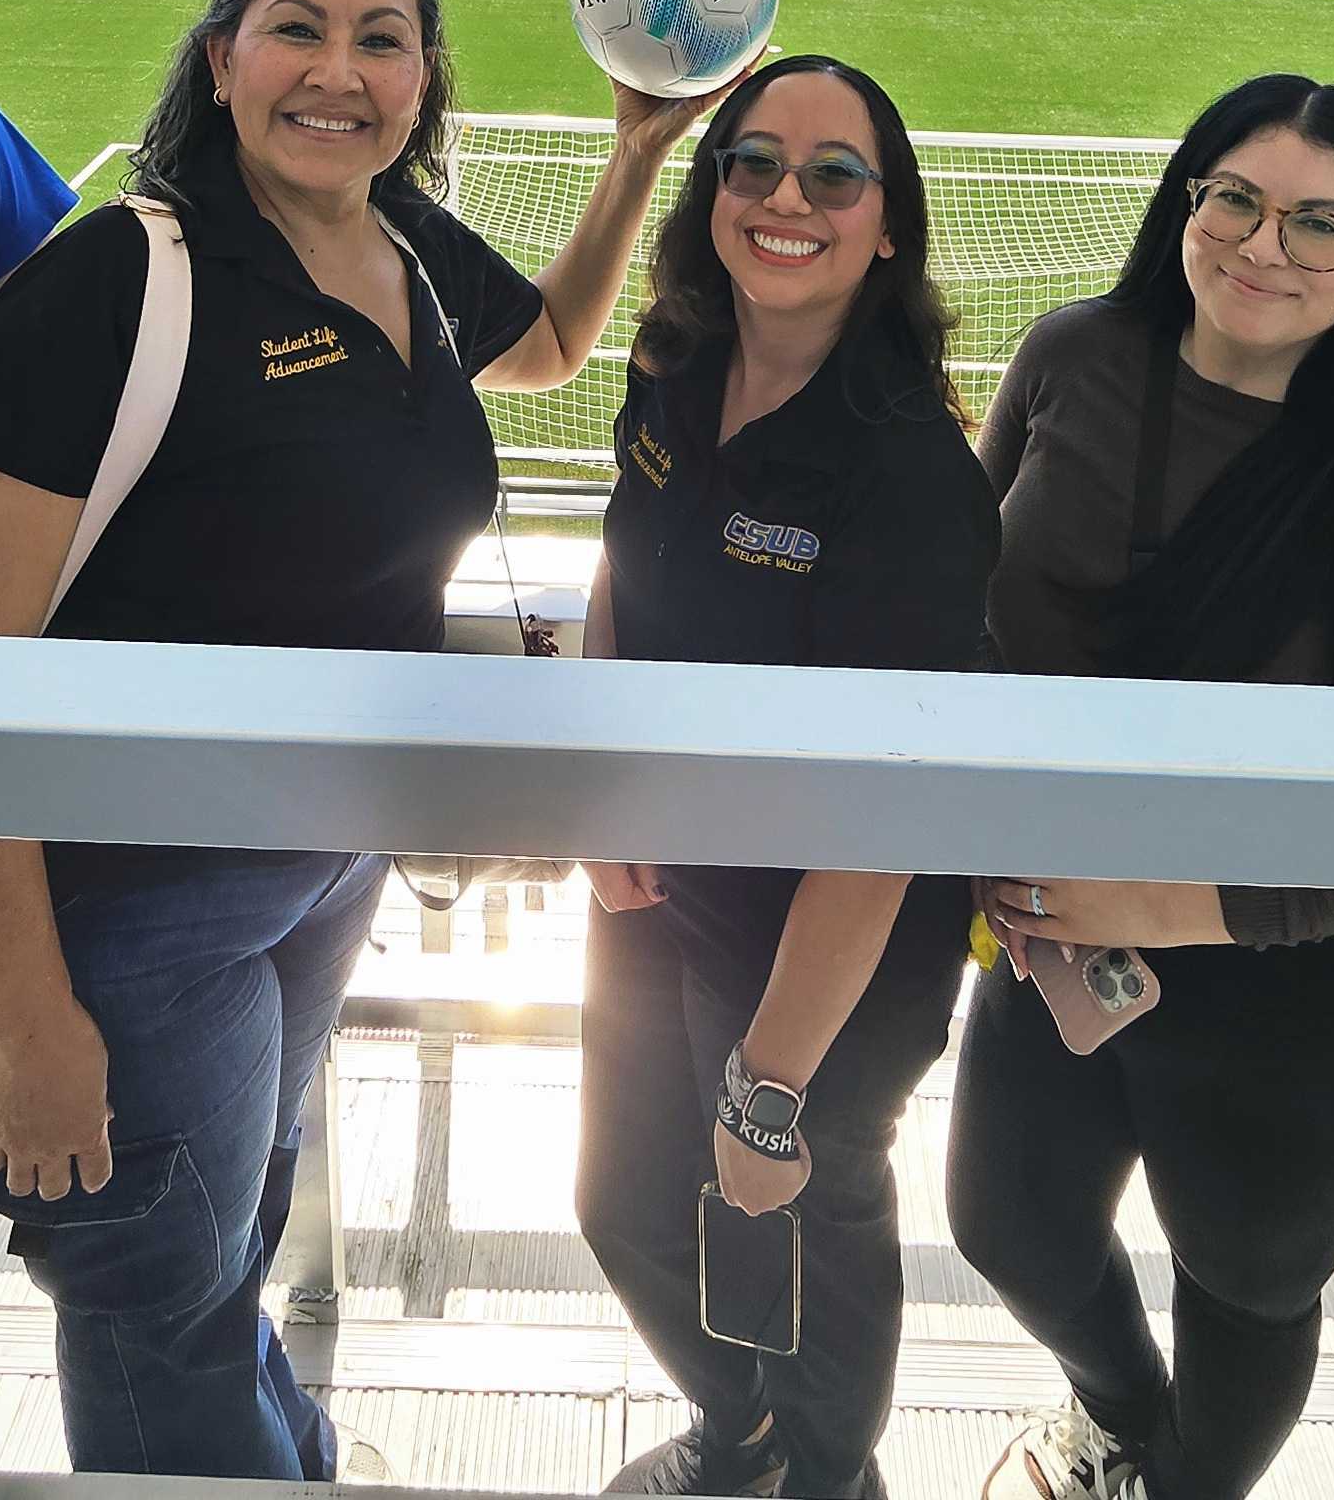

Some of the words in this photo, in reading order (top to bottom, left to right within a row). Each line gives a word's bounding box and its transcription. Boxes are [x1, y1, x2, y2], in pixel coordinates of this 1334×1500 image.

[261, 331, 312, 358] Student
[311, 326, 339, 348] Life
[264, 346, 349, 381] Advancement
[723, 511, 820, 561] CSUB
[723, 544, 773, 567] ANTELOPE
[775, 555, 815, 574] VALLEY
[738, 1120, 797, 1153] KUSH
